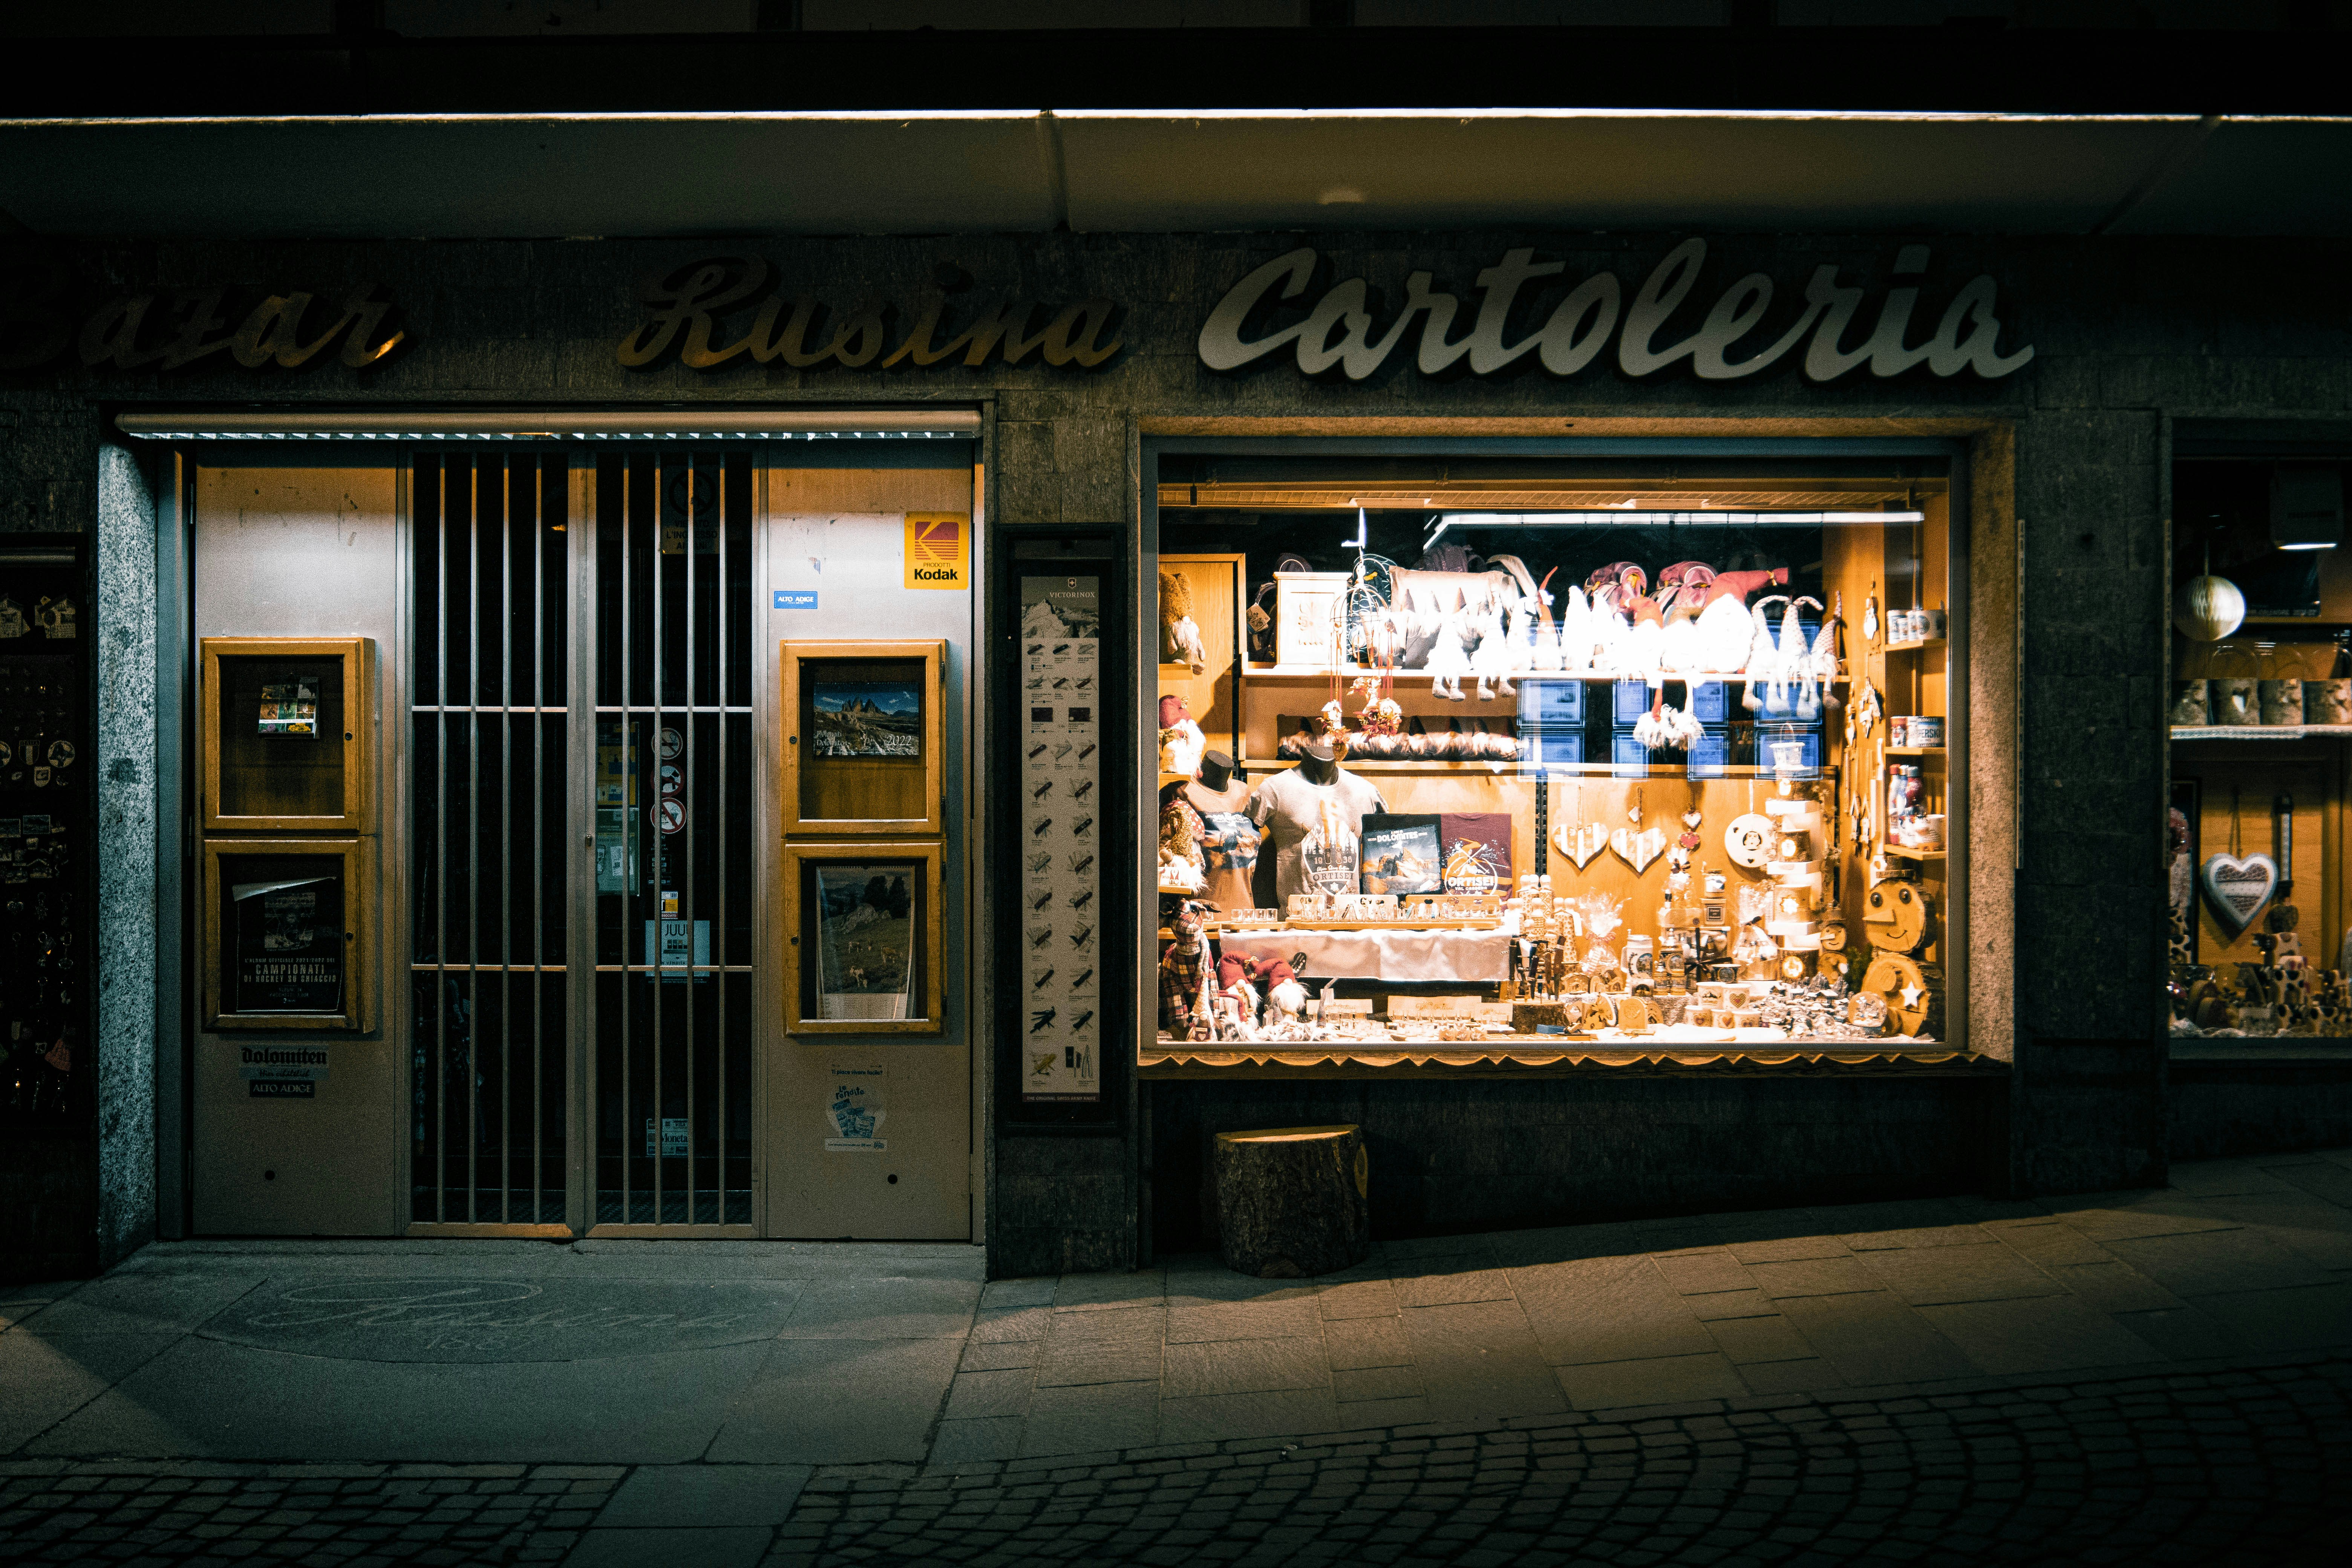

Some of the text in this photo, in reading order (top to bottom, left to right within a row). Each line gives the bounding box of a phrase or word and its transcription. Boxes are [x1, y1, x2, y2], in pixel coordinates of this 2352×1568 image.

[617, 260, 1125, 370] Rusina
[1198, 237, 2035, 381] Cartoleria
[914, 568, 958, 580] Kodak
[887, 735, 912, 746] 2022
[1377, 831, 1418, 842] DOLOMITES
[1448, 877, 1494, 887] ORTISEI
[665, 924, 689, 936] JUU
[256, 964, 325, 974] CAMPIONATI
[242, 1047, 326, 1064] Dolomiten
[253, 1084, 311, 1093] ALTO ADIGE
[836, 1087, 864, 1099] rendite
